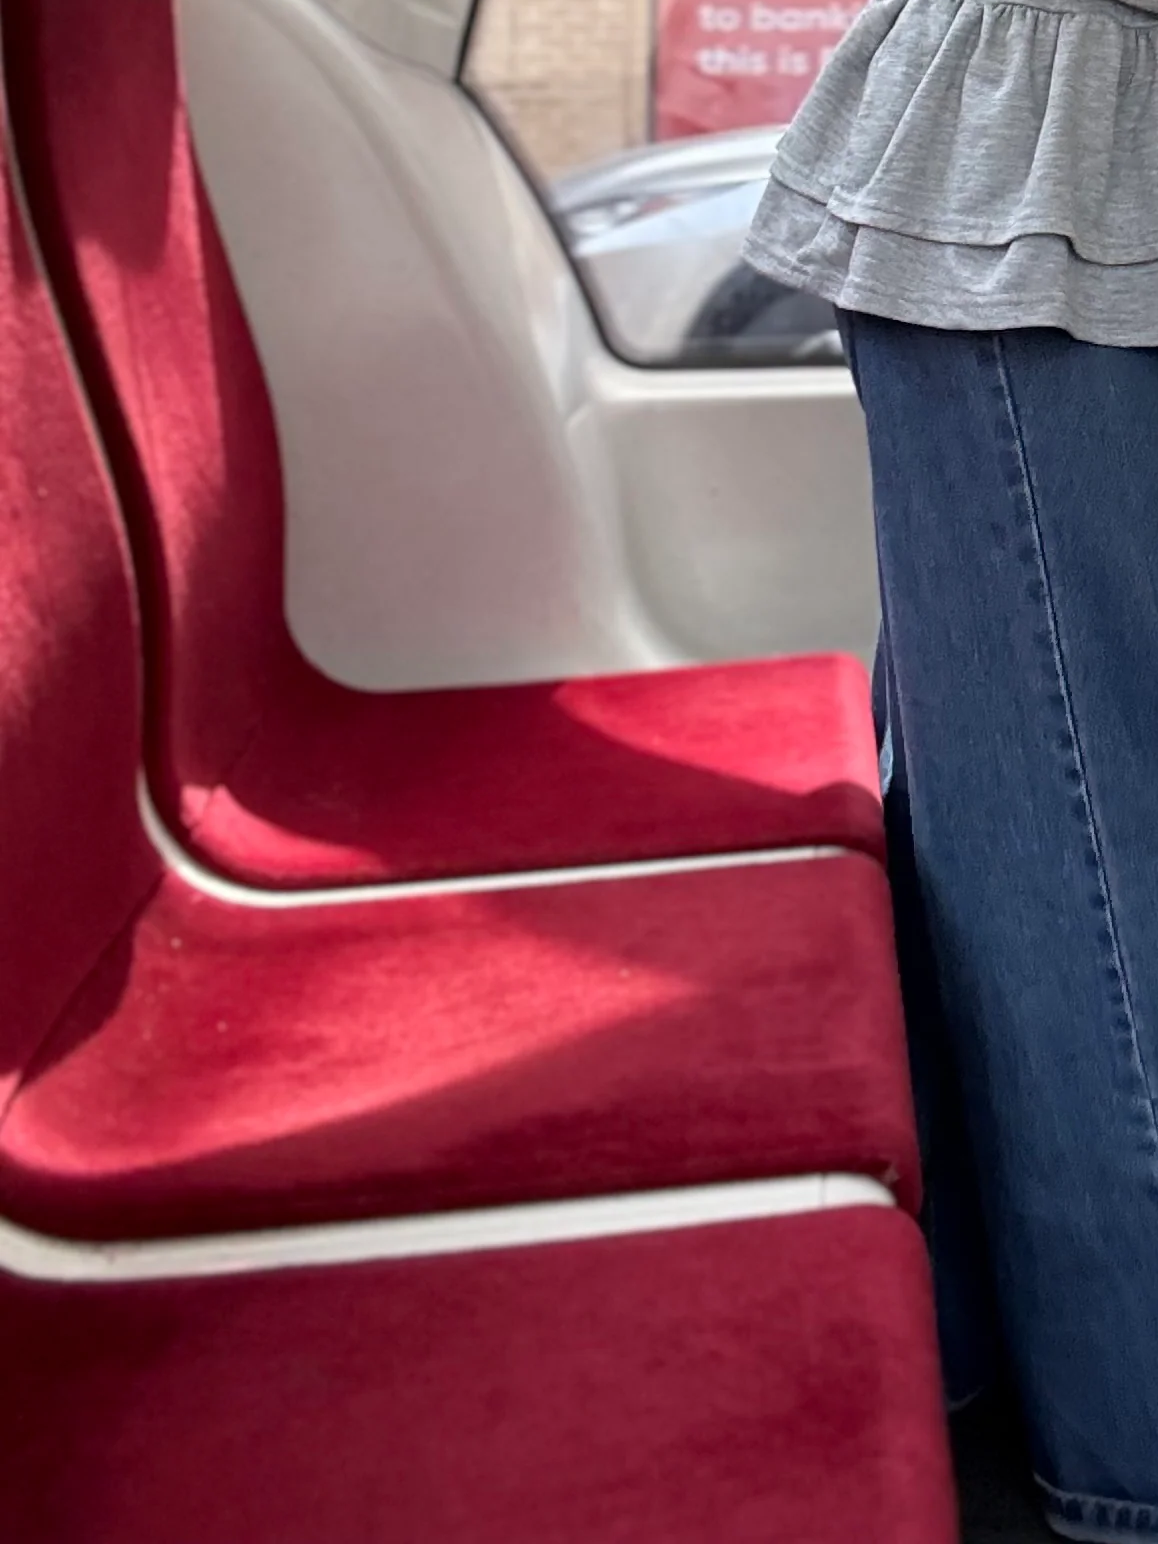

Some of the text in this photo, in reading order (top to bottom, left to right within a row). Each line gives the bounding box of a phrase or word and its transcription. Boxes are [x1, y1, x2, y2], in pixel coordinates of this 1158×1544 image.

[700, 3, 740, 32] to
[700, 45, 767, 76] this
[777, 45, 809, 76] is
